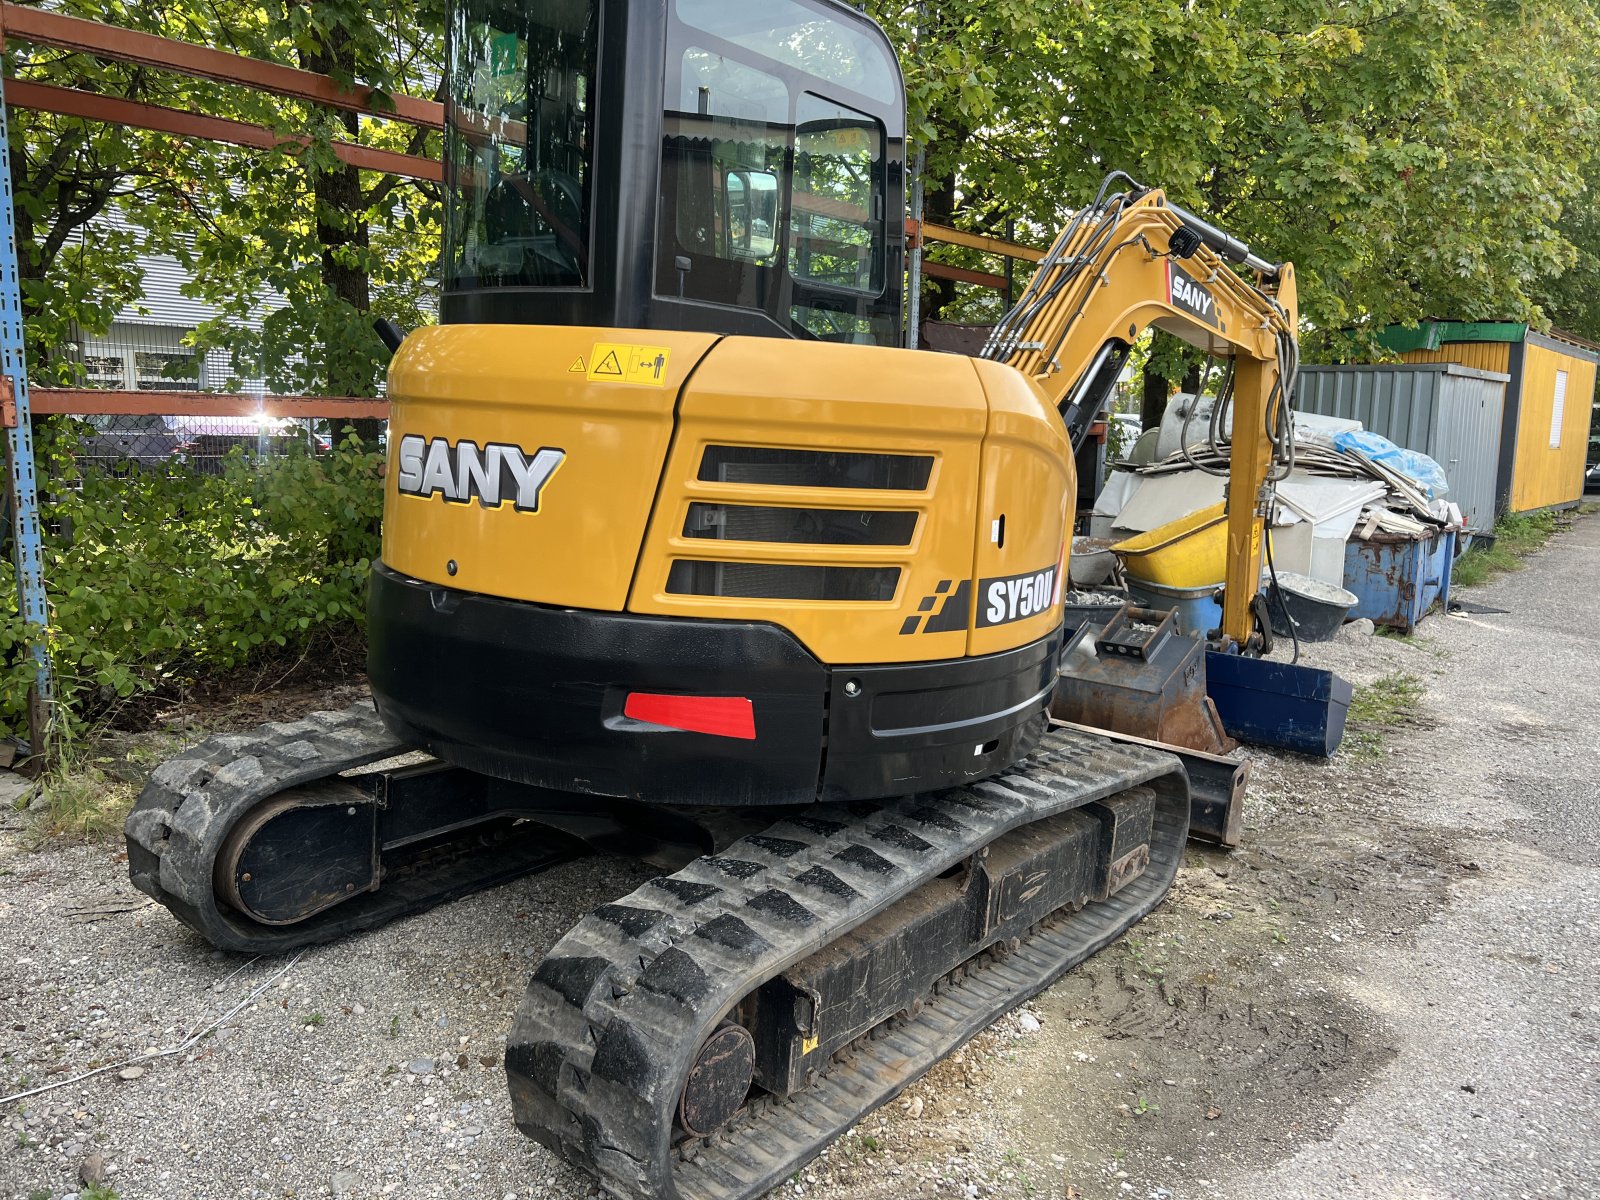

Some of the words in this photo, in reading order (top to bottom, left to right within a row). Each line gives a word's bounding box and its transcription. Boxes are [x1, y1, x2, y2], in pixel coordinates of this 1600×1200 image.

[1172, 275, 1212, 315] SANY
[399, 434, 566, 511] SANY
[986, 569, 1054, 624] SY50U
